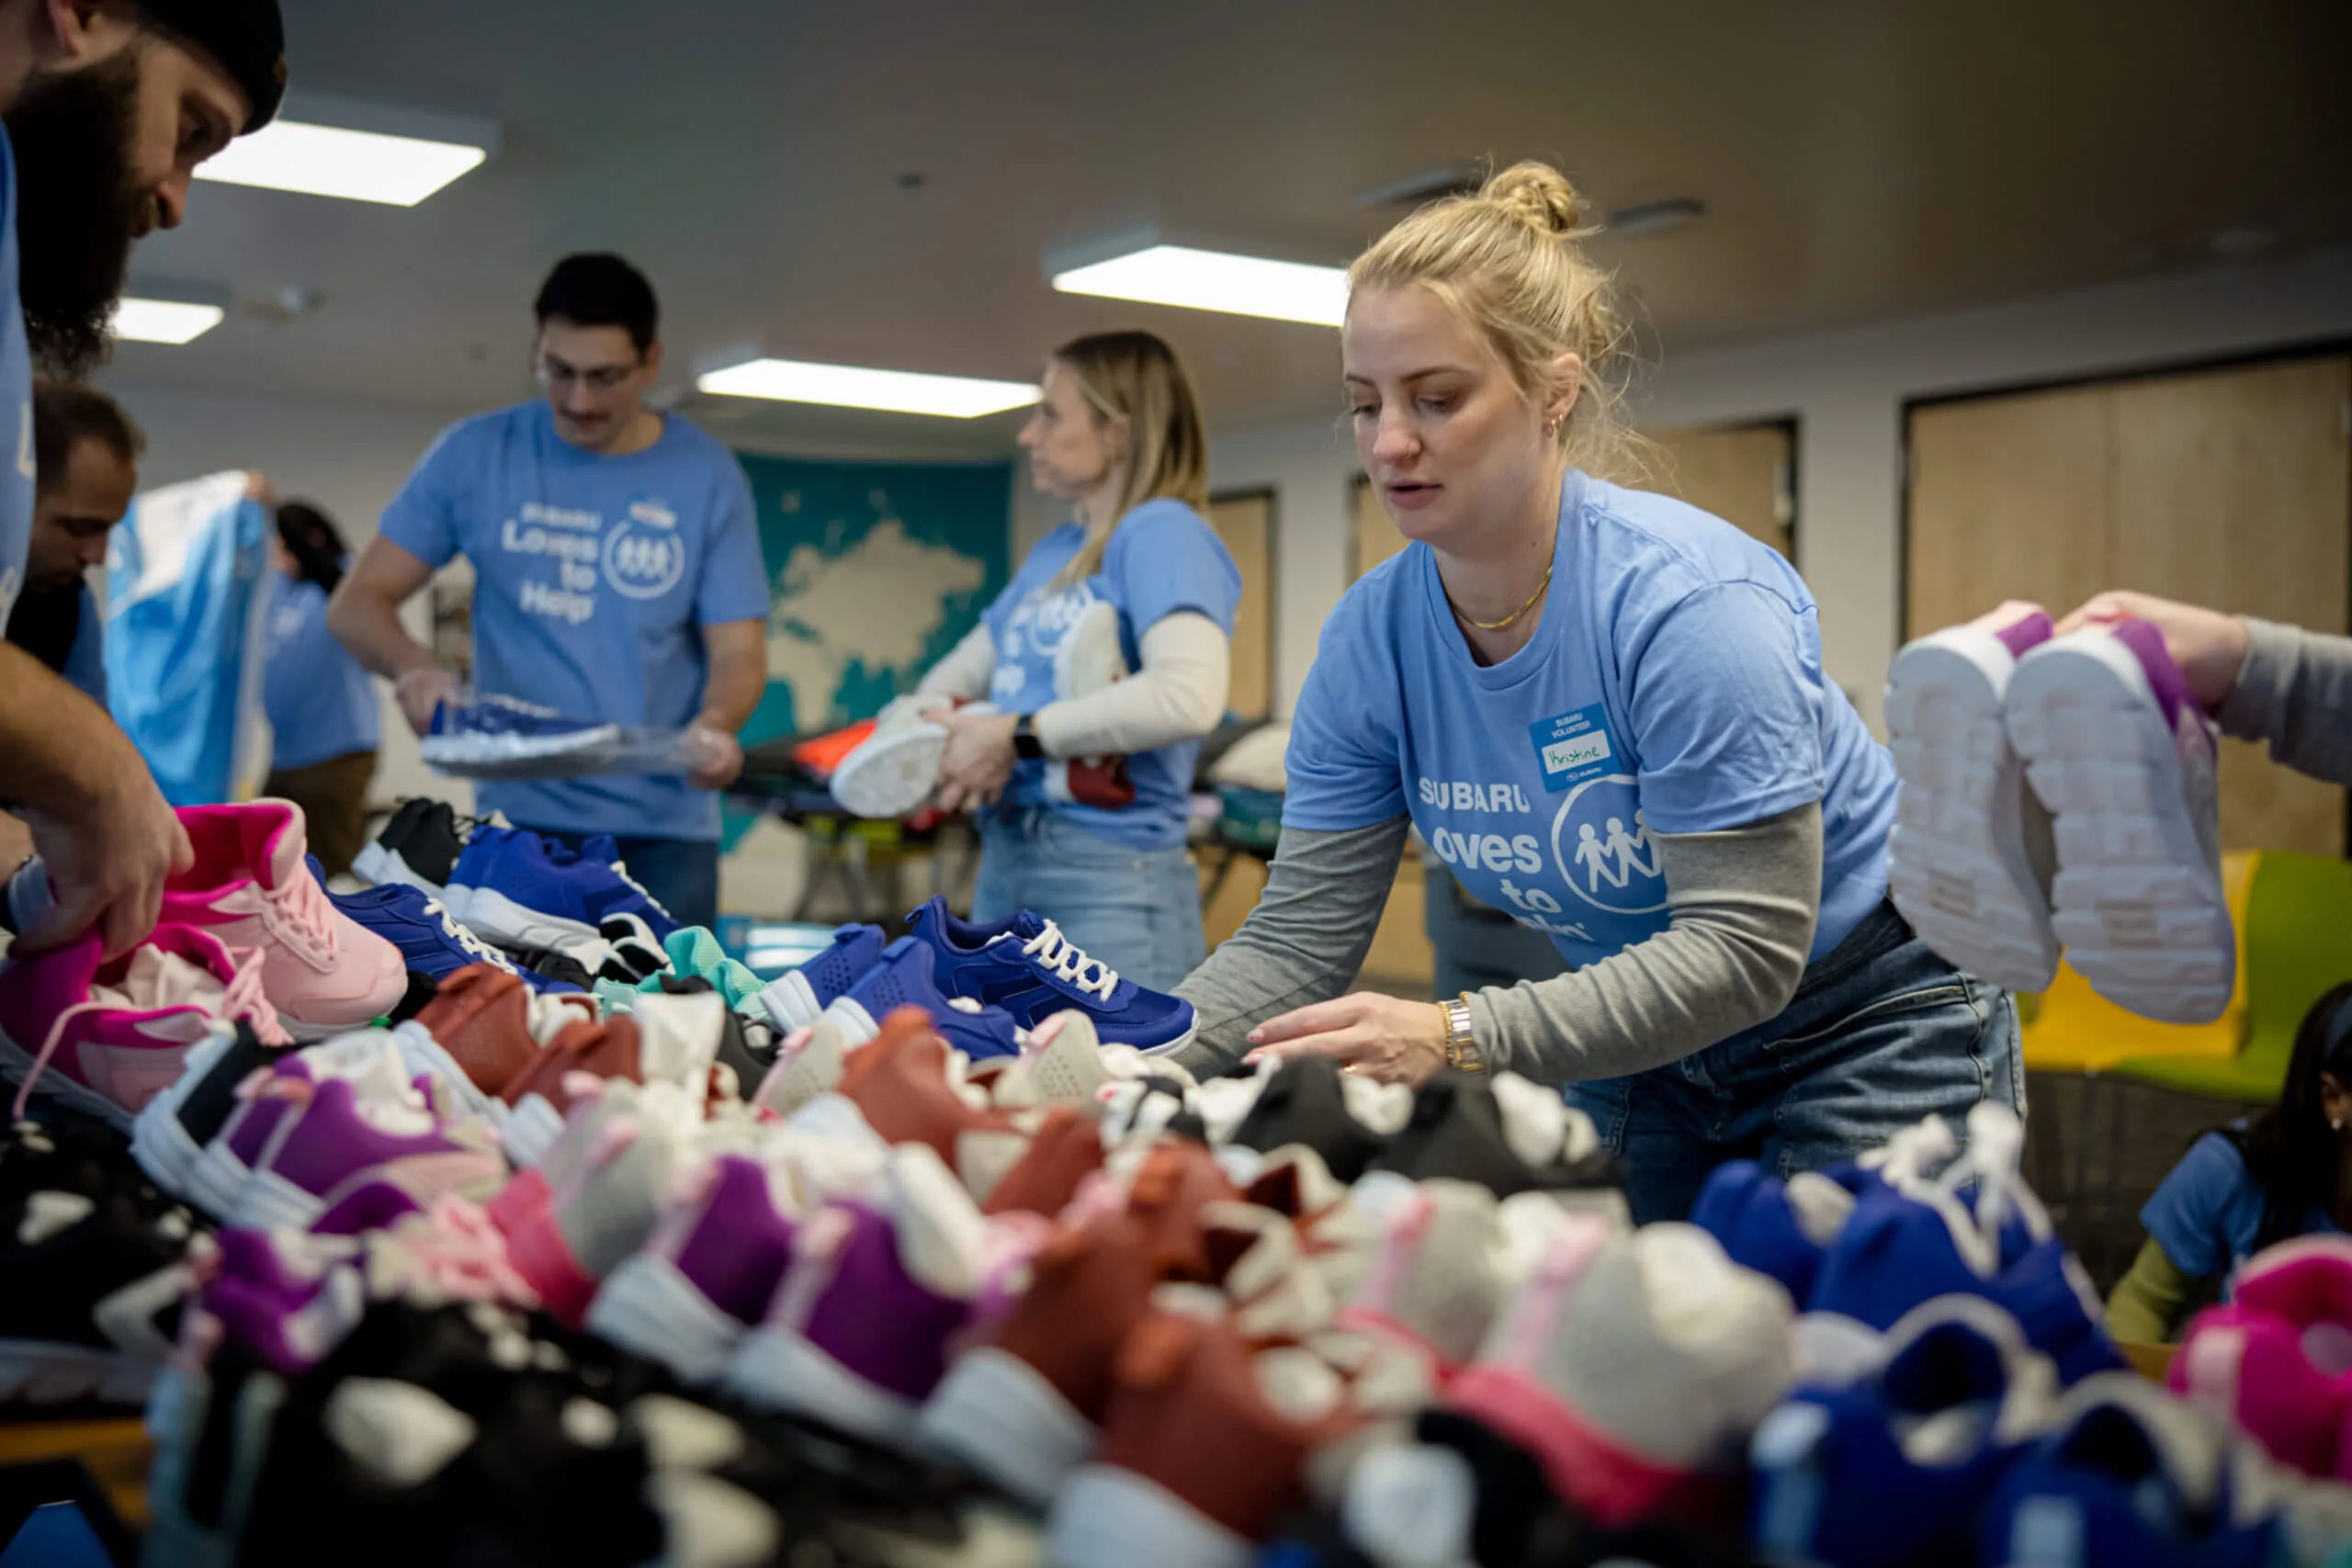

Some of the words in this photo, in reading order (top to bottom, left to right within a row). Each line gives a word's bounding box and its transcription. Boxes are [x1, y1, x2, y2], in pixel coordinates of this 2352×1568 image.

[503, 520, 597, 562] Loves
[561, 558, 597, 591] to
[520, 581, 594, 625] Help
[1552, 721, 1590, 738] VOLUNTEER
[1432, 827, 1543, 874] oves
[1500, 878, 1562, 913] to
